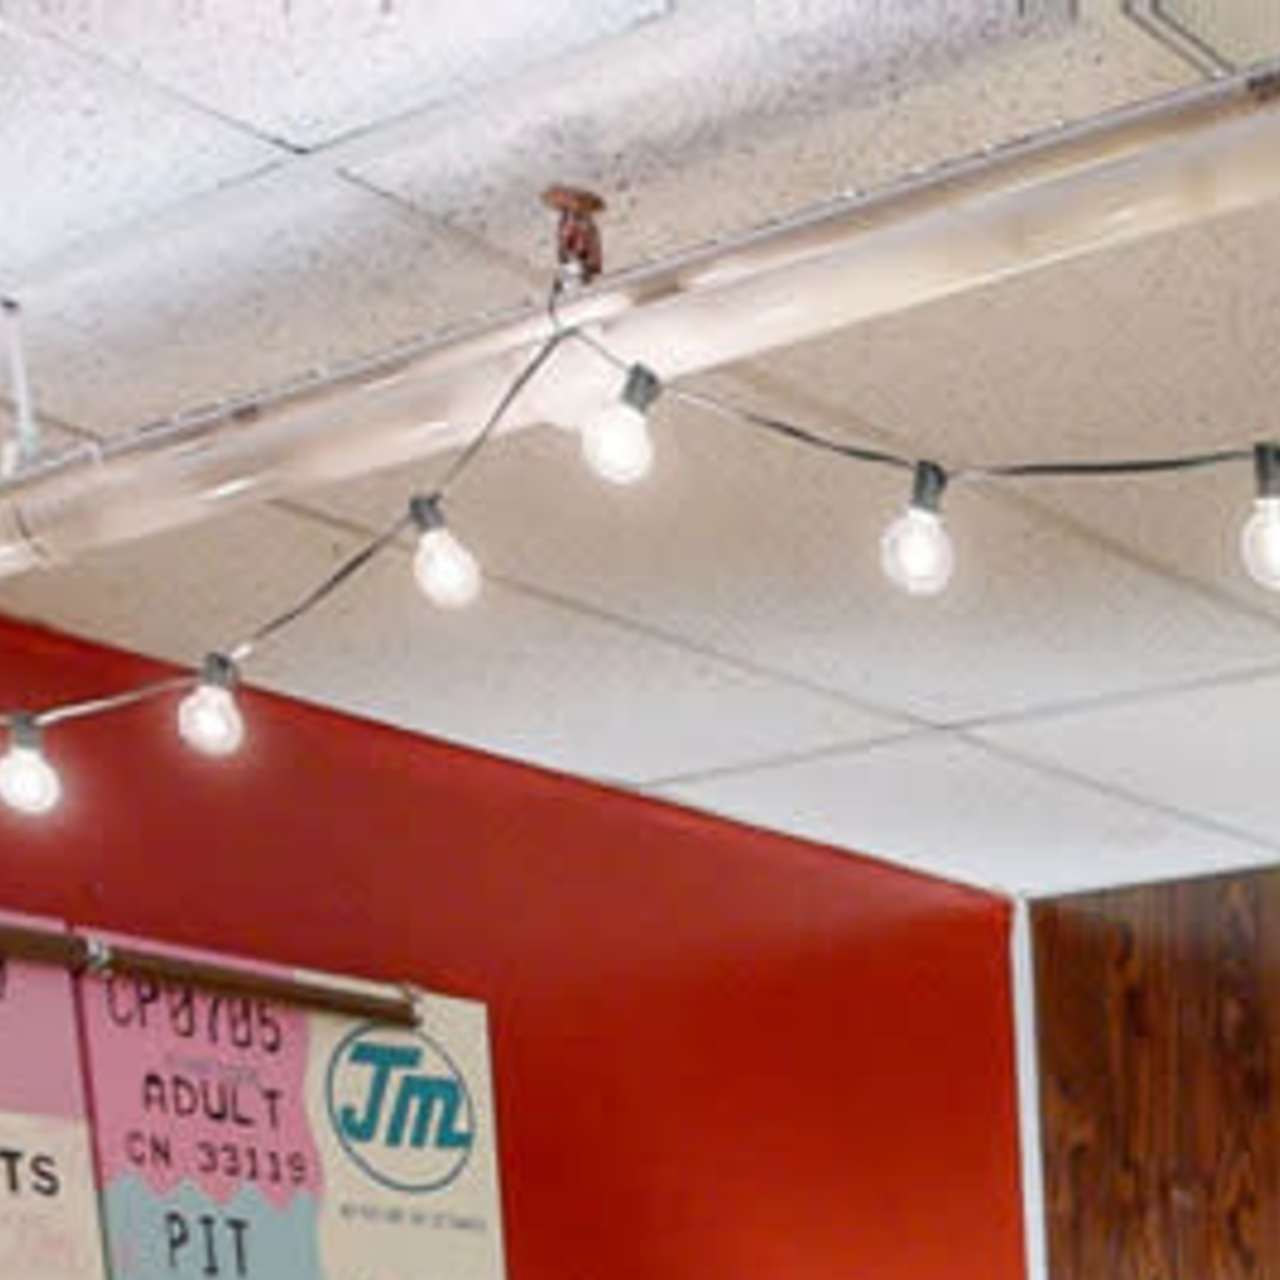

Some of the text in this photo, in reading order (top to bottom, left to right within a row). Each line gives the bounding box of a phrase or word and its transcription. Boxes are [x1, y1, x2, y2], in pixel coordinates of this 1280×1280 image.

[144, 1074, 284, 1128] ADULT
[126, 1132, 174, 1168] CN
[164, 1212, 250, 1278] PIT
